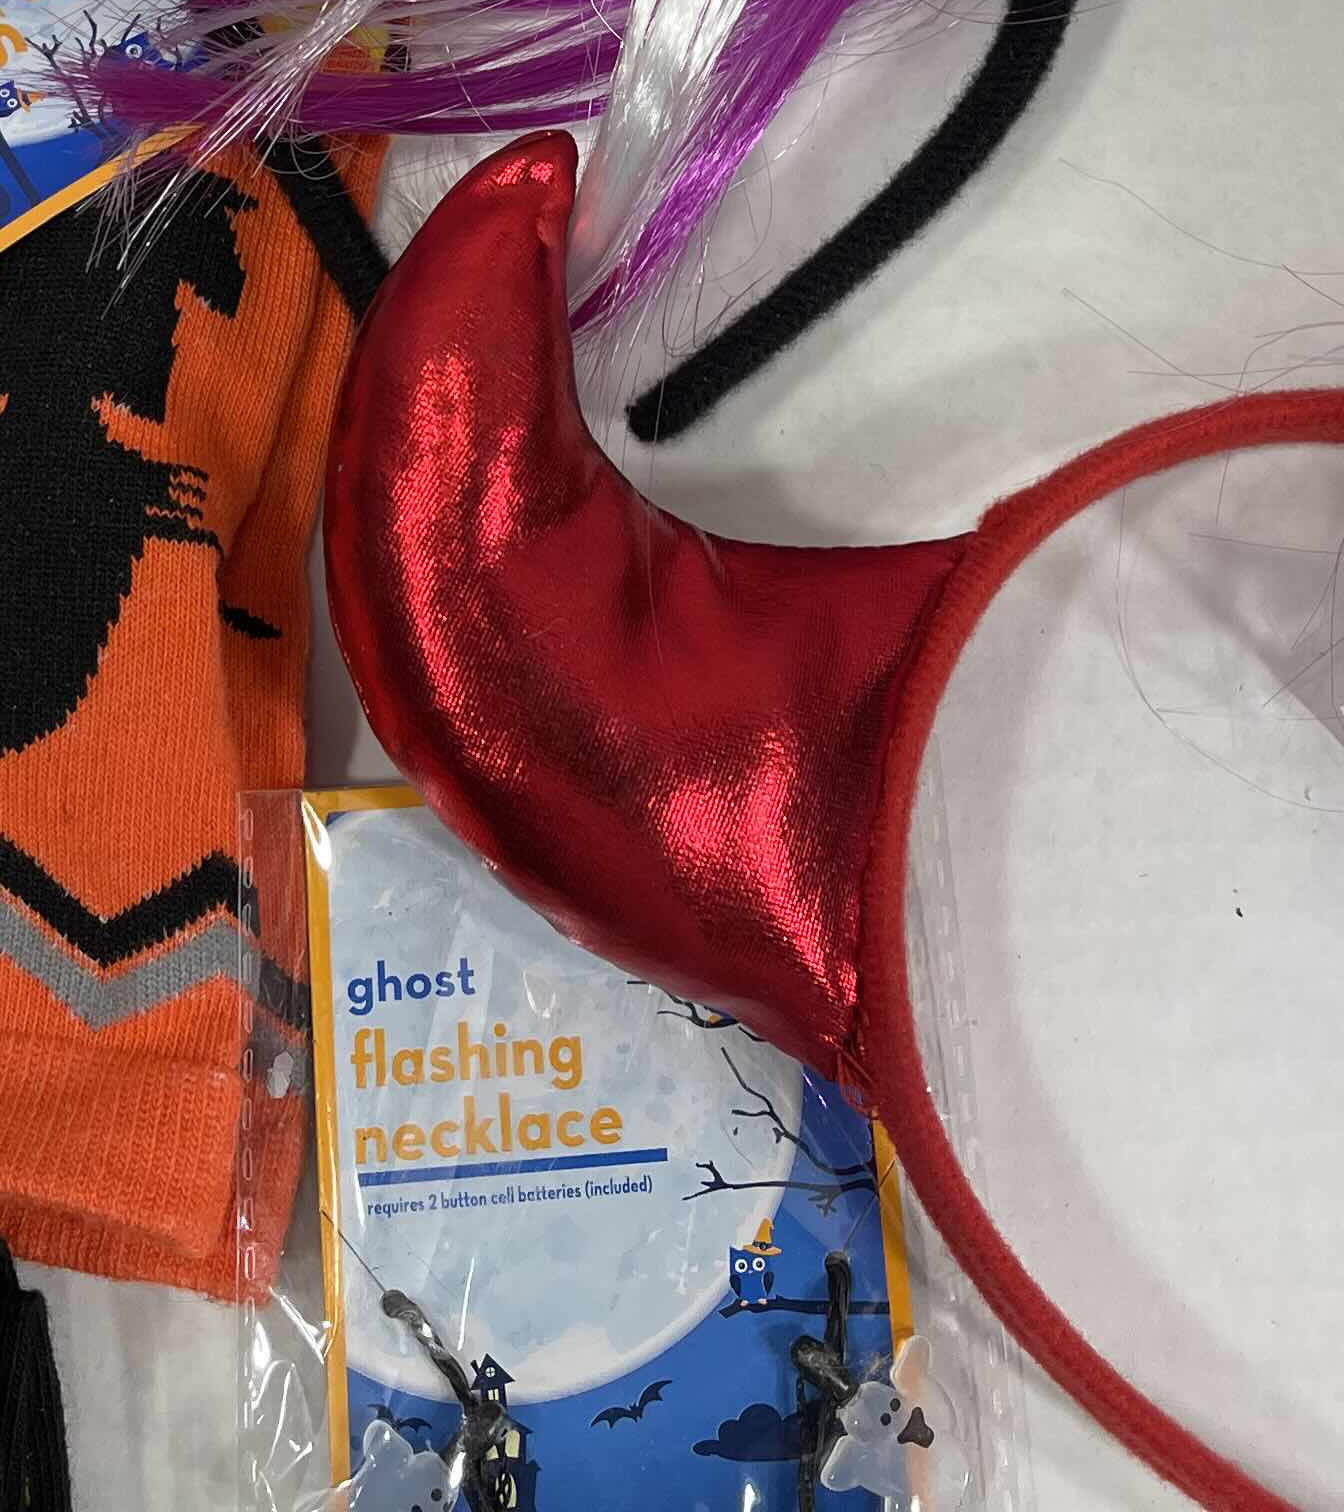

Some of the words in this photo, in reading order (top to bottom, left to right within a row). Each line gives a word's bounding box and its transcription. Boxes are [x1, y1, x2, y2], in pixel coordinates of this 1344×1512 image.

[347, 957, 476, 1016] ghost
[350, 1020, 584, 1090] flashing
[355, 1092, 625, 1165] necklace
[367, 1195, 425, 1216] requires
[427, 1193, 437, 1210] 2
[439, 1188, 487, 1209] button
[491, 1188, 515, 1206] cell
[519, 1182, 581, 1204] batteries
[585, 1177, 654, 1201] (included)
